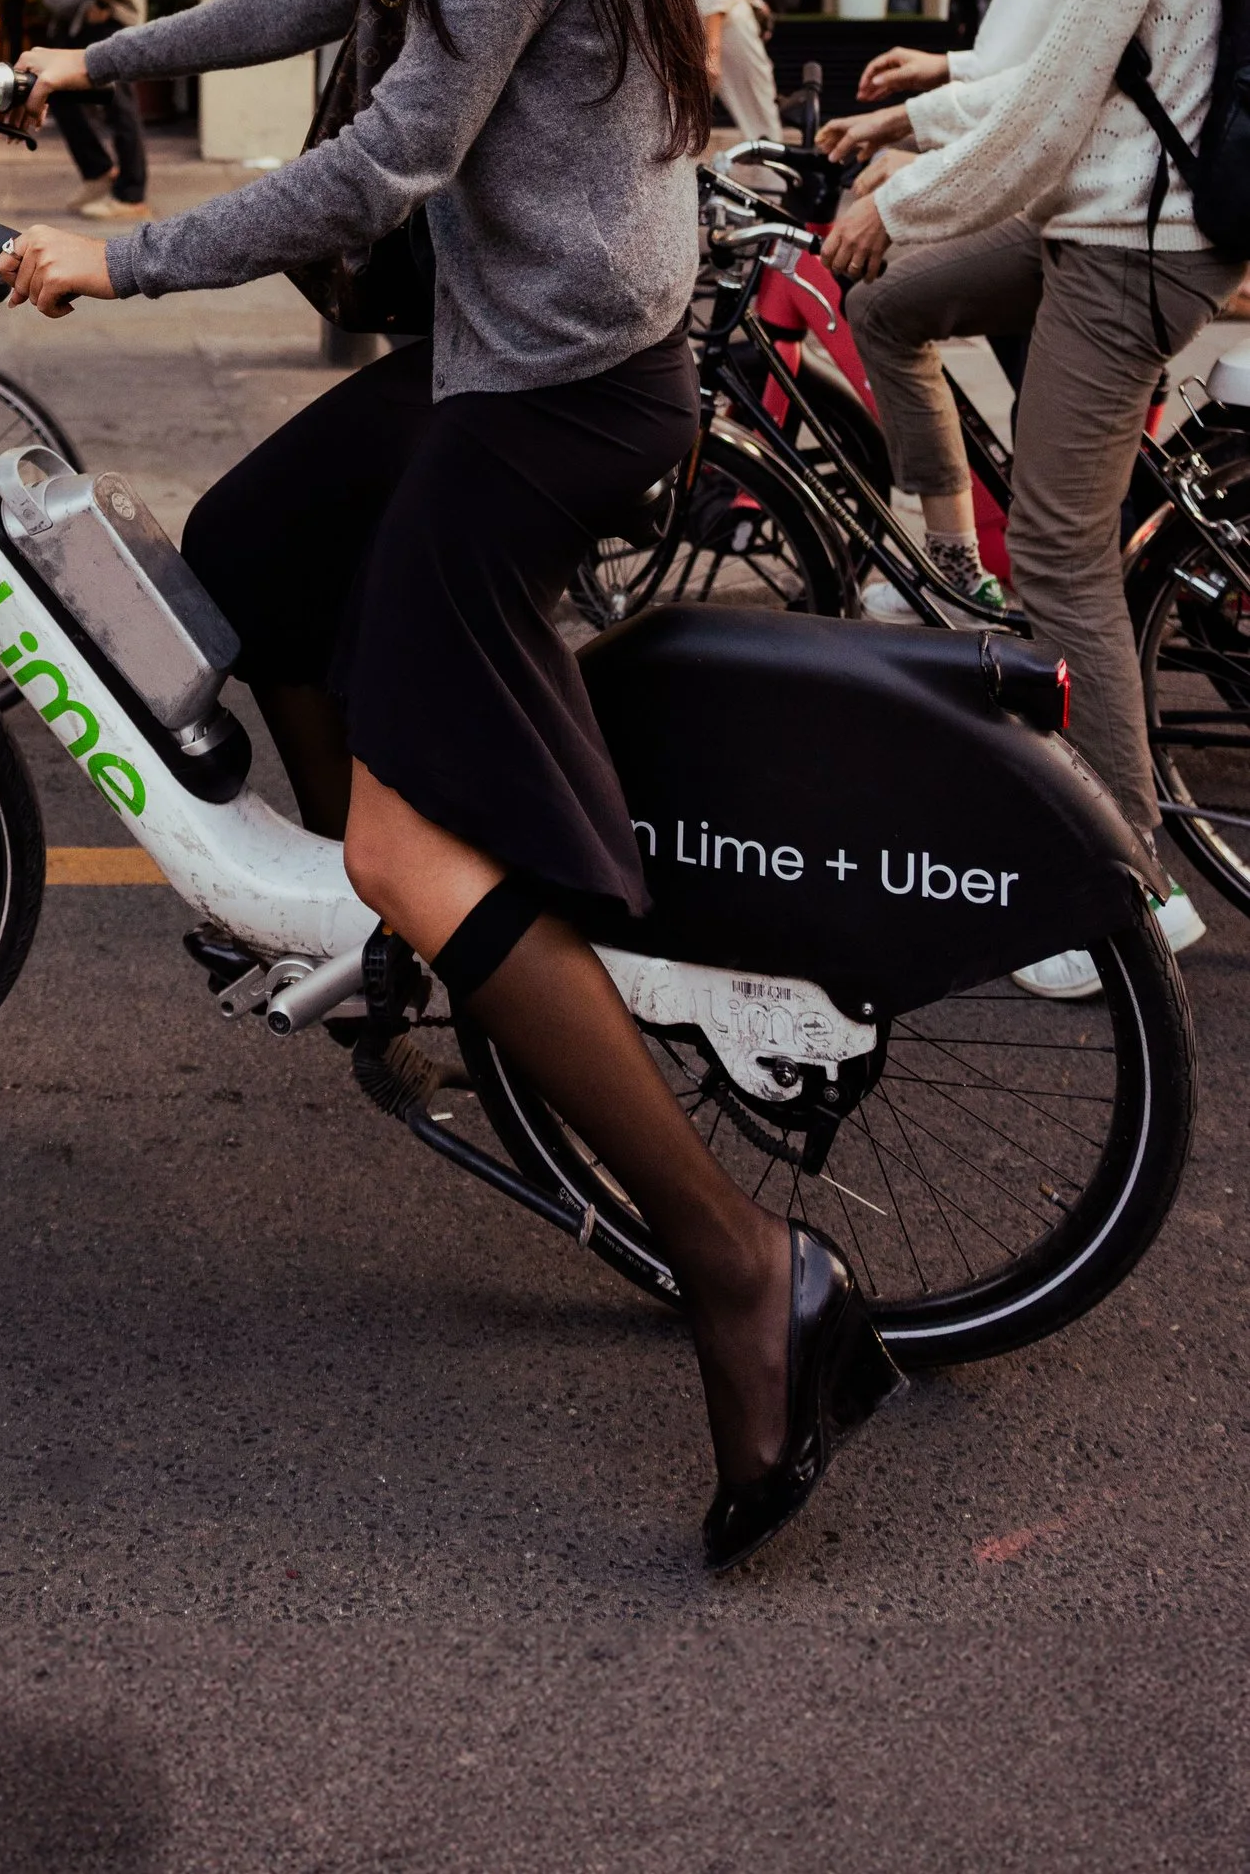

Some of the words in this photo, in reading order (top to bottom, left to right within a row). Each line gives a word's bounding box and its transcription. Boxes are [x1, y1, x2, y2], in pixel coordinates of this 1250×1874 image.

[676, 819, 805, 882] Lime
[825, 848, 858, 882] +
[881, 848, 1020, 907] Uber
